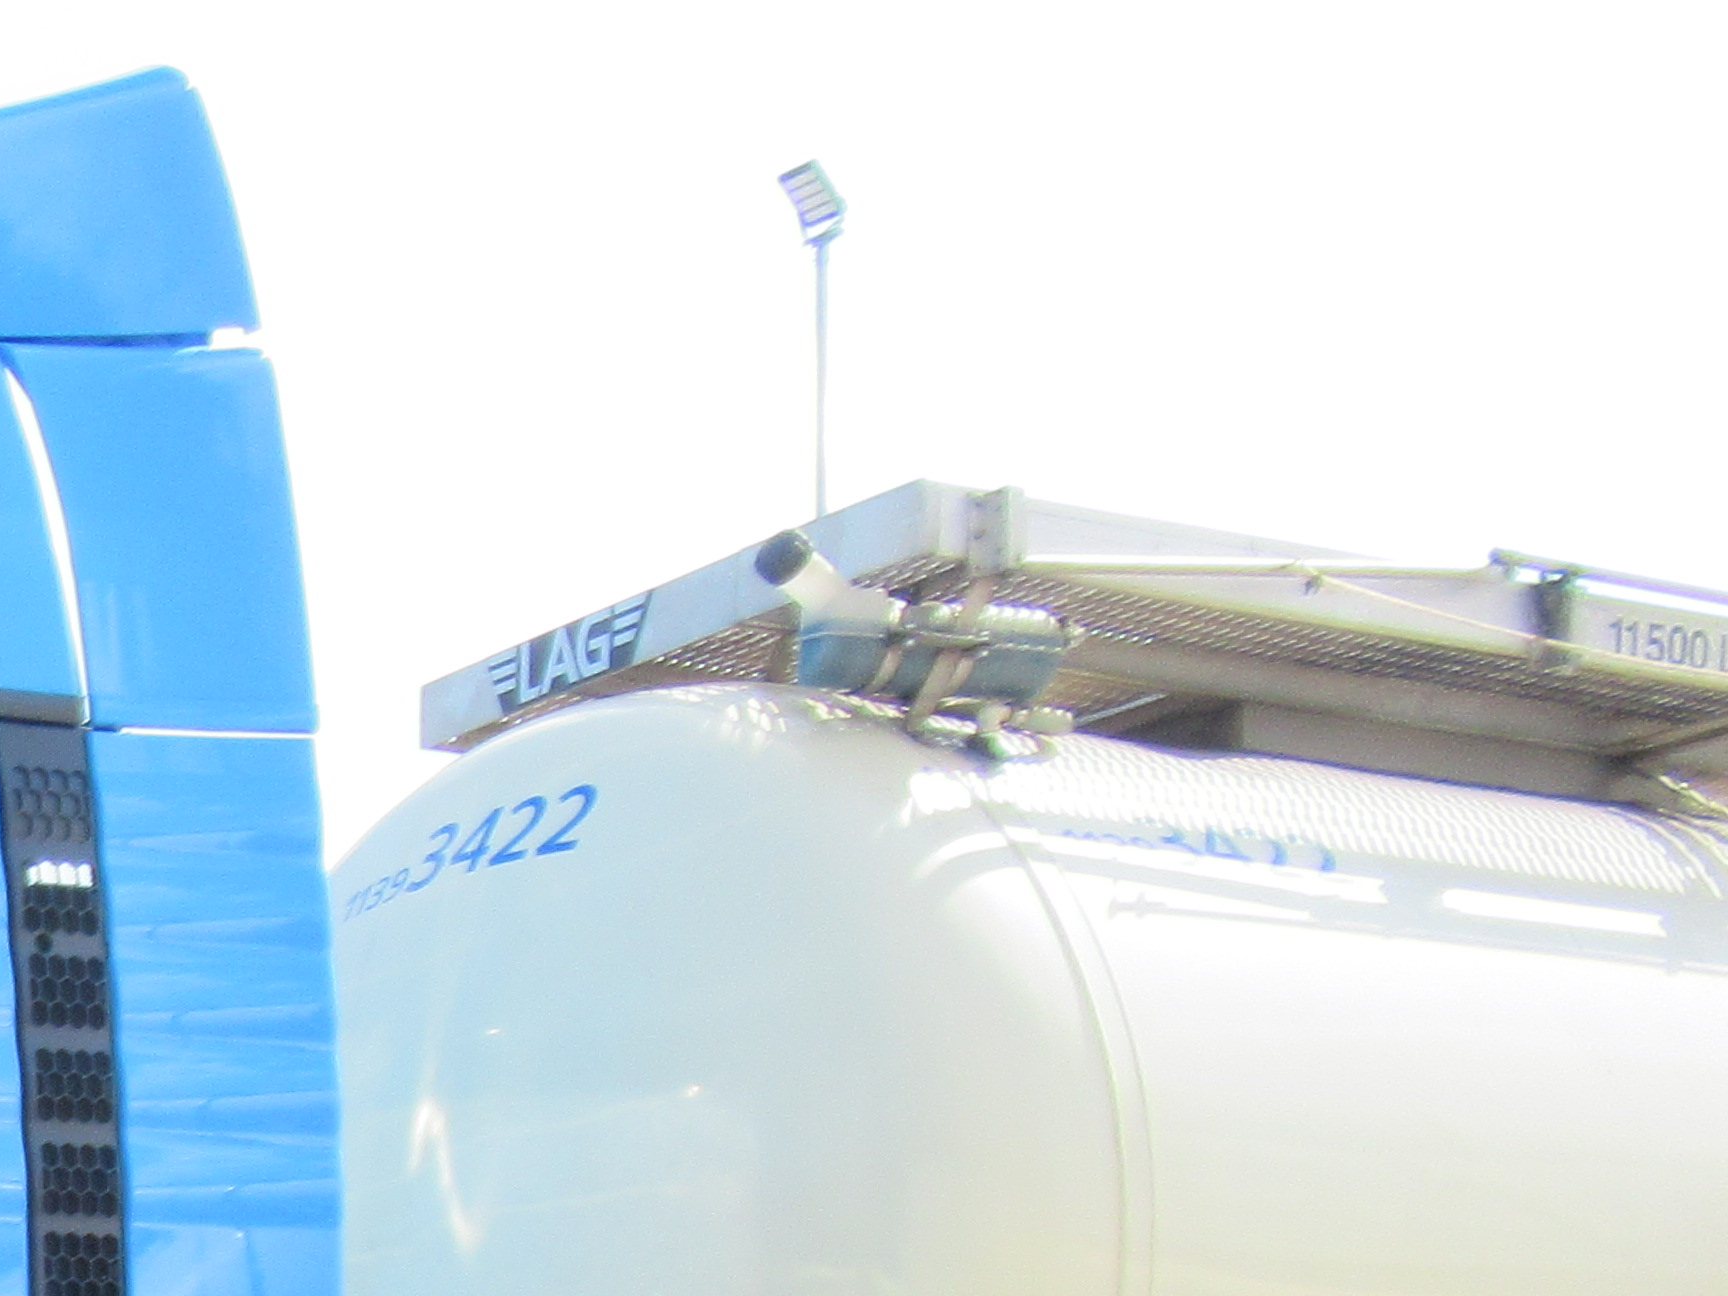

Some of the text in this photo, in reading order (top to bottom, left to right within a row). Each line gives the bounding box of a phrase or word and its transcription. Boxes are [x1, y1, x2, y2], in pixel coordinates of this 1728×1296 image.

[517, 609, 612, 706] LAG
[1608, 617, 1710, 668] 11500
[405, 784, 599, 893] 3422
